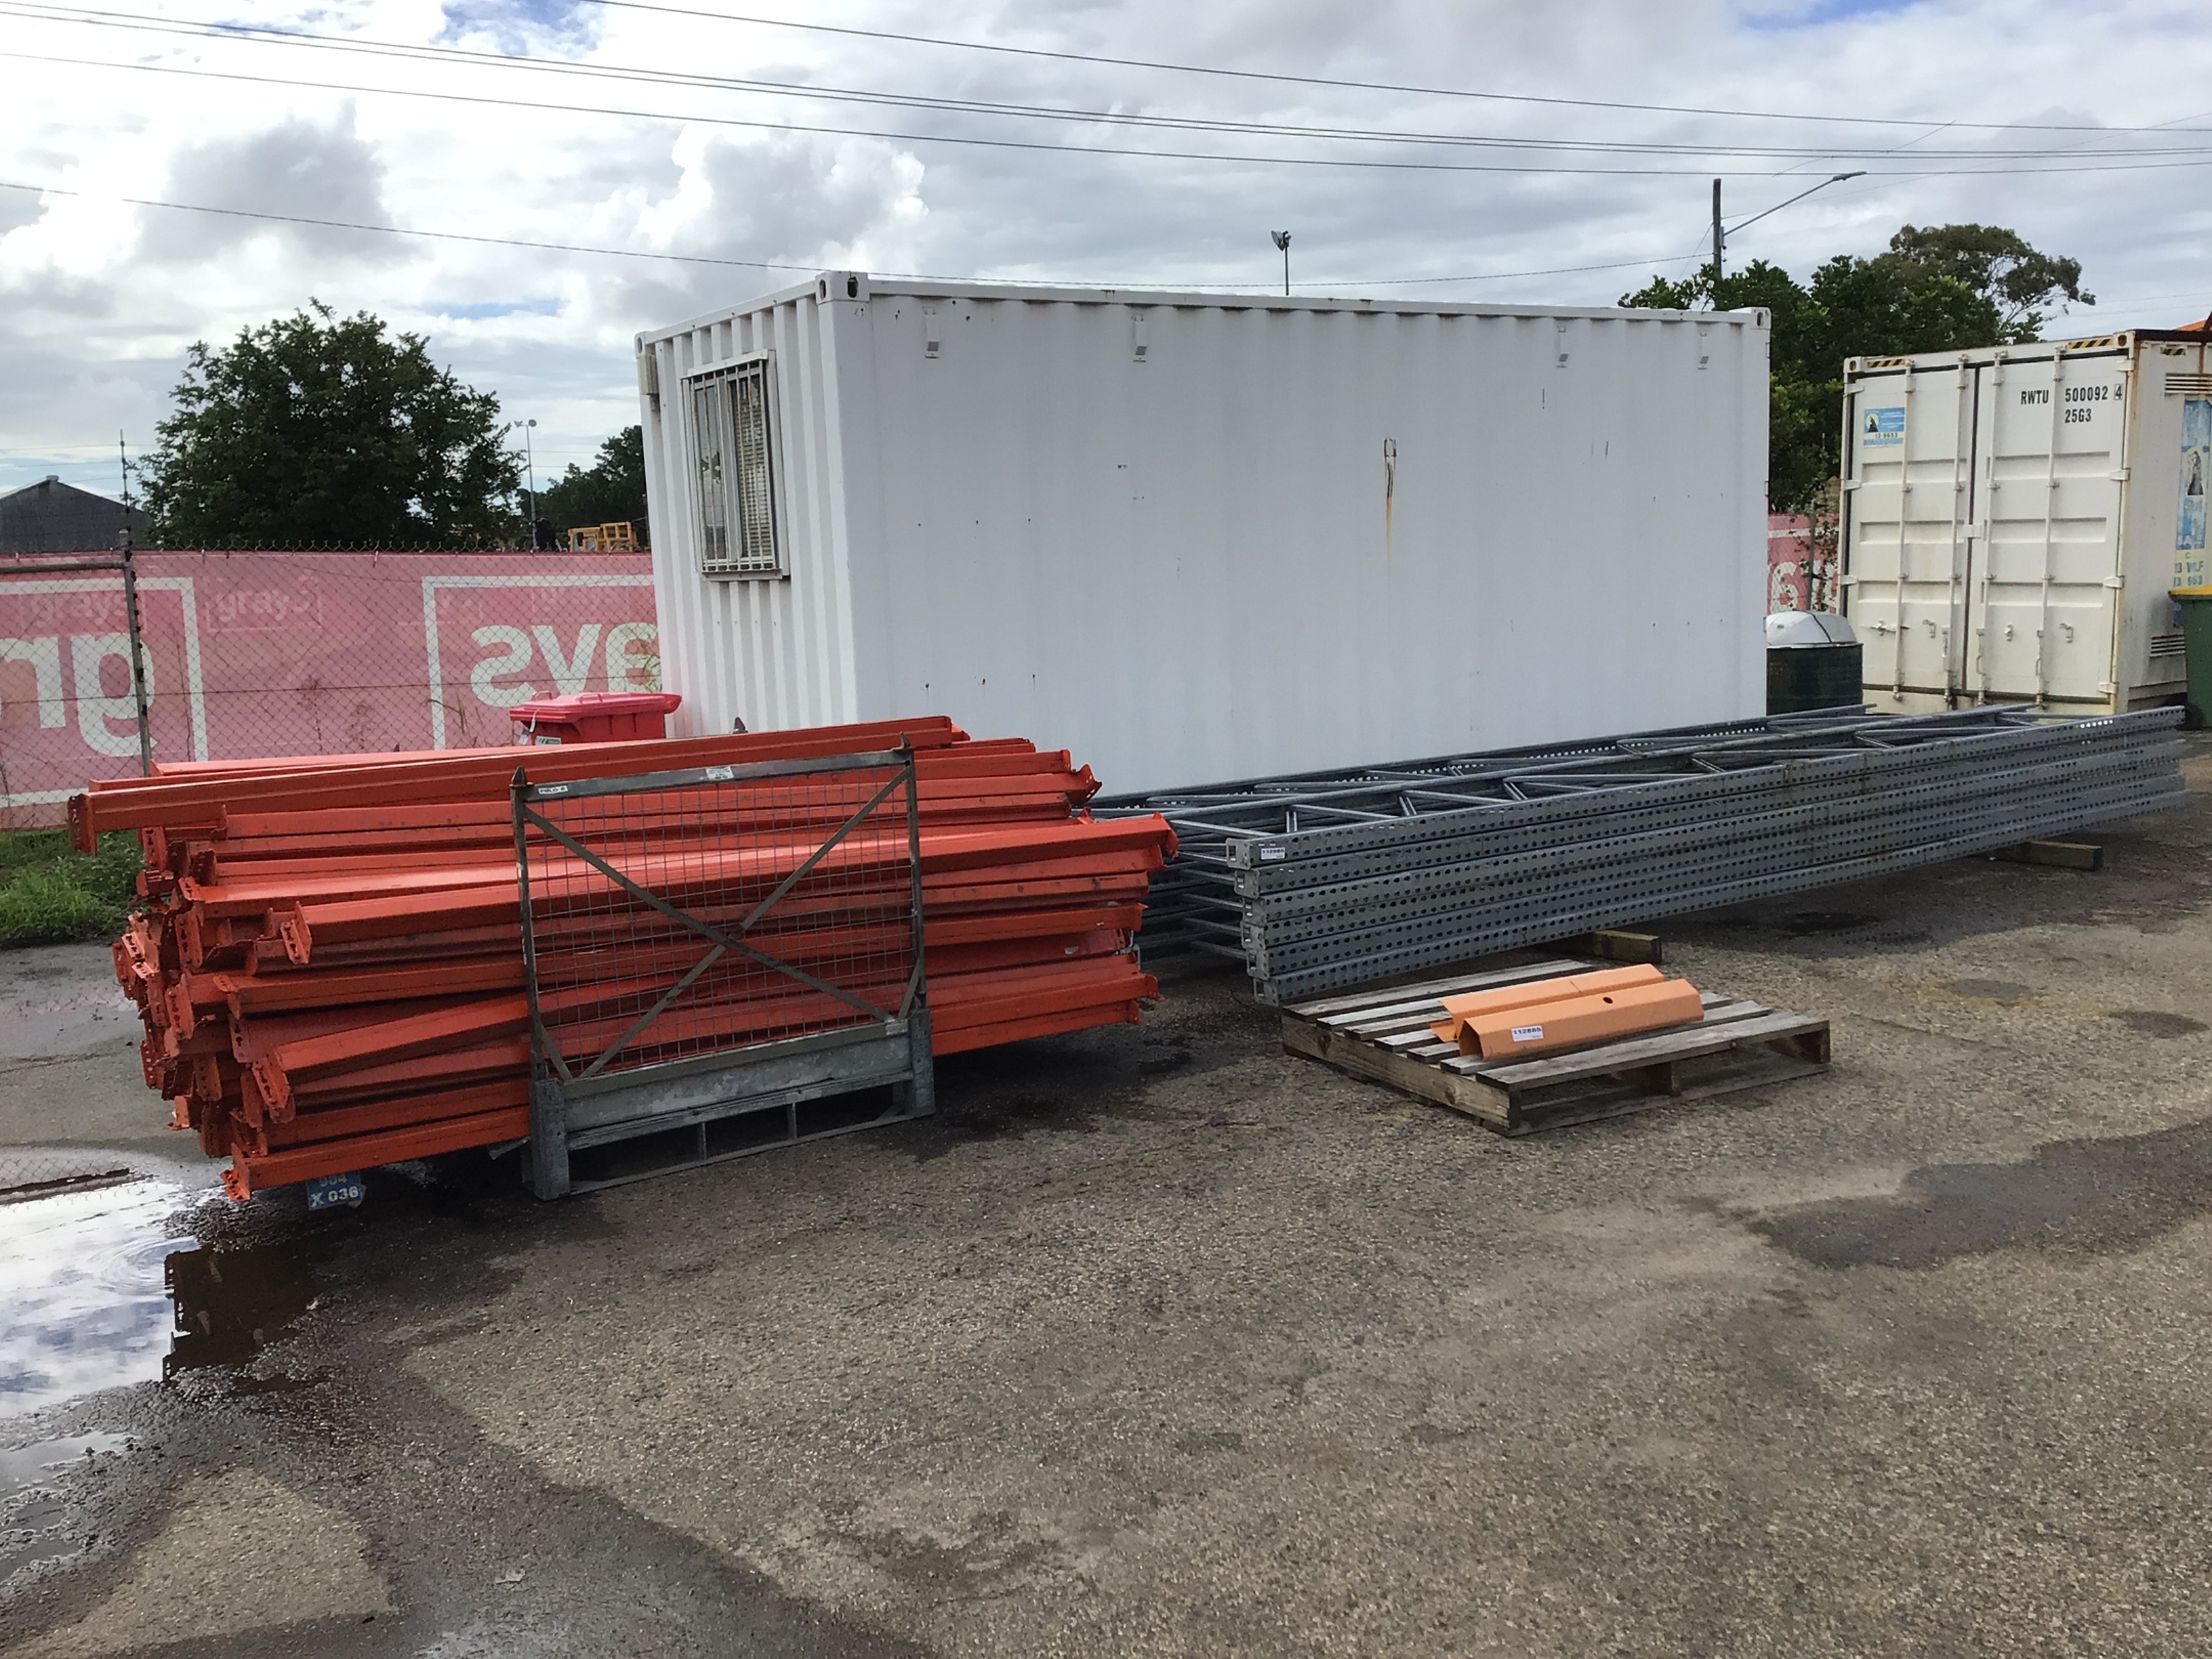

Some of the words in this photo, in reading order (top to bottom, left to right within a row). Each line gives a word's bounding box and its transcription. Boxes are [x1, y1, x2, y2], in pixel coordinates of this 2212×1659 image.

[2020, 390, 2049, 405] RWTU
[2065, 386, 2108, 402] 500092
[2115, 385, 2123, 398] 4
[2065, 408, 2092, 423] 25G3
[310, 1193, 325, 1207] X
[328, 1186, 359, 1202] 036
